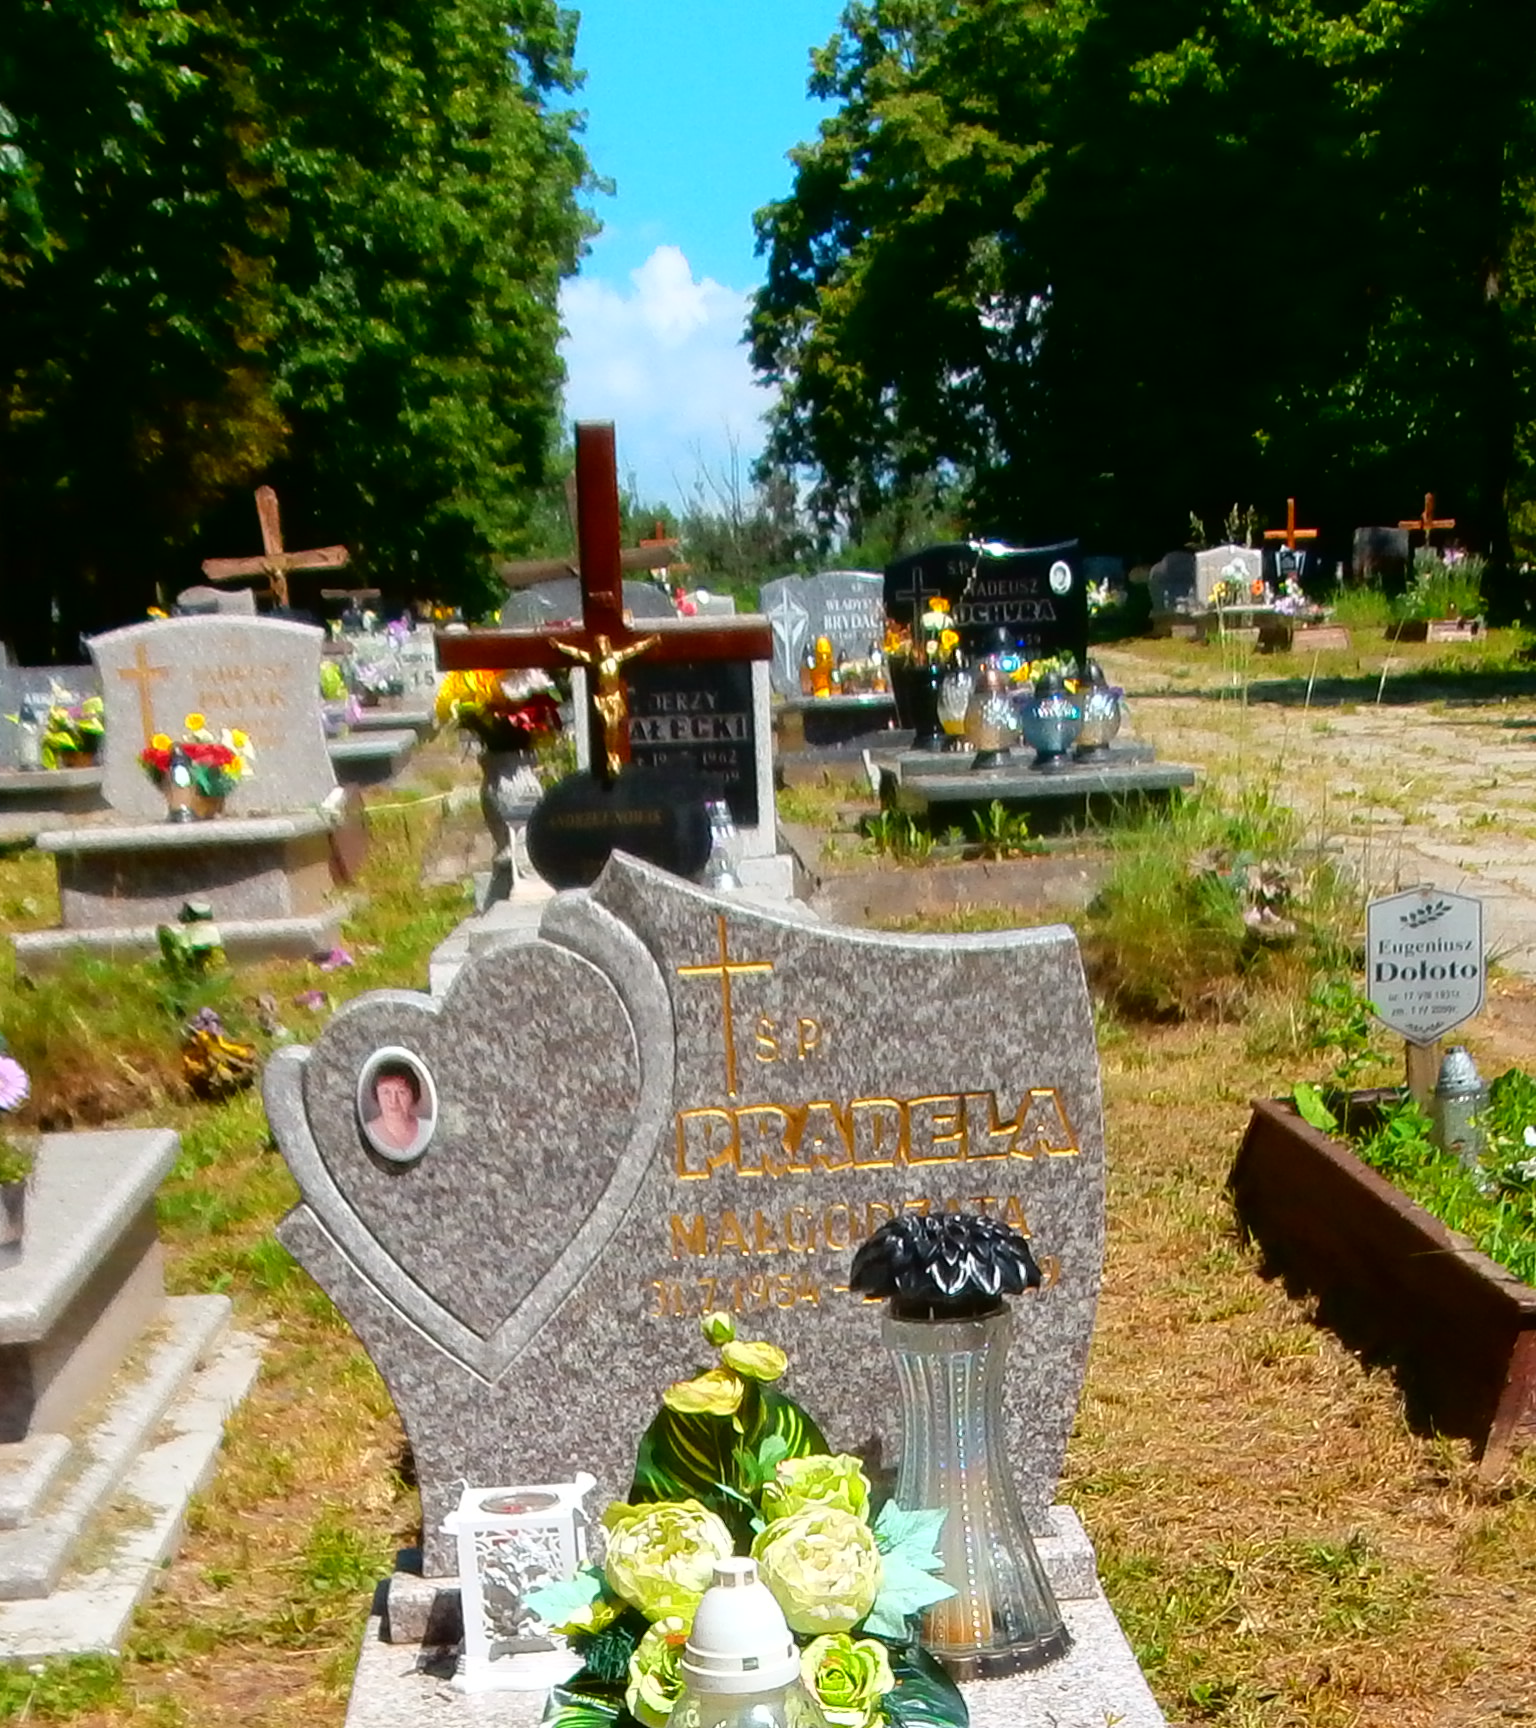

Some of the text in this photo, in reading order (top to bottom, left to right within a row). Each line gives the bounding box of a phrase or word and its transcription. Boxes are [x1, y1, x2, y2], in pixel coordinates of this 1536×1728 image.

[649, 691, 719, 711] JERZY
[629, 713, 748, 744] AŁECKI
[1378, 937, 1473, 958] Eugeniusz
[676, 1087, 1080, 1181] PRADELA
